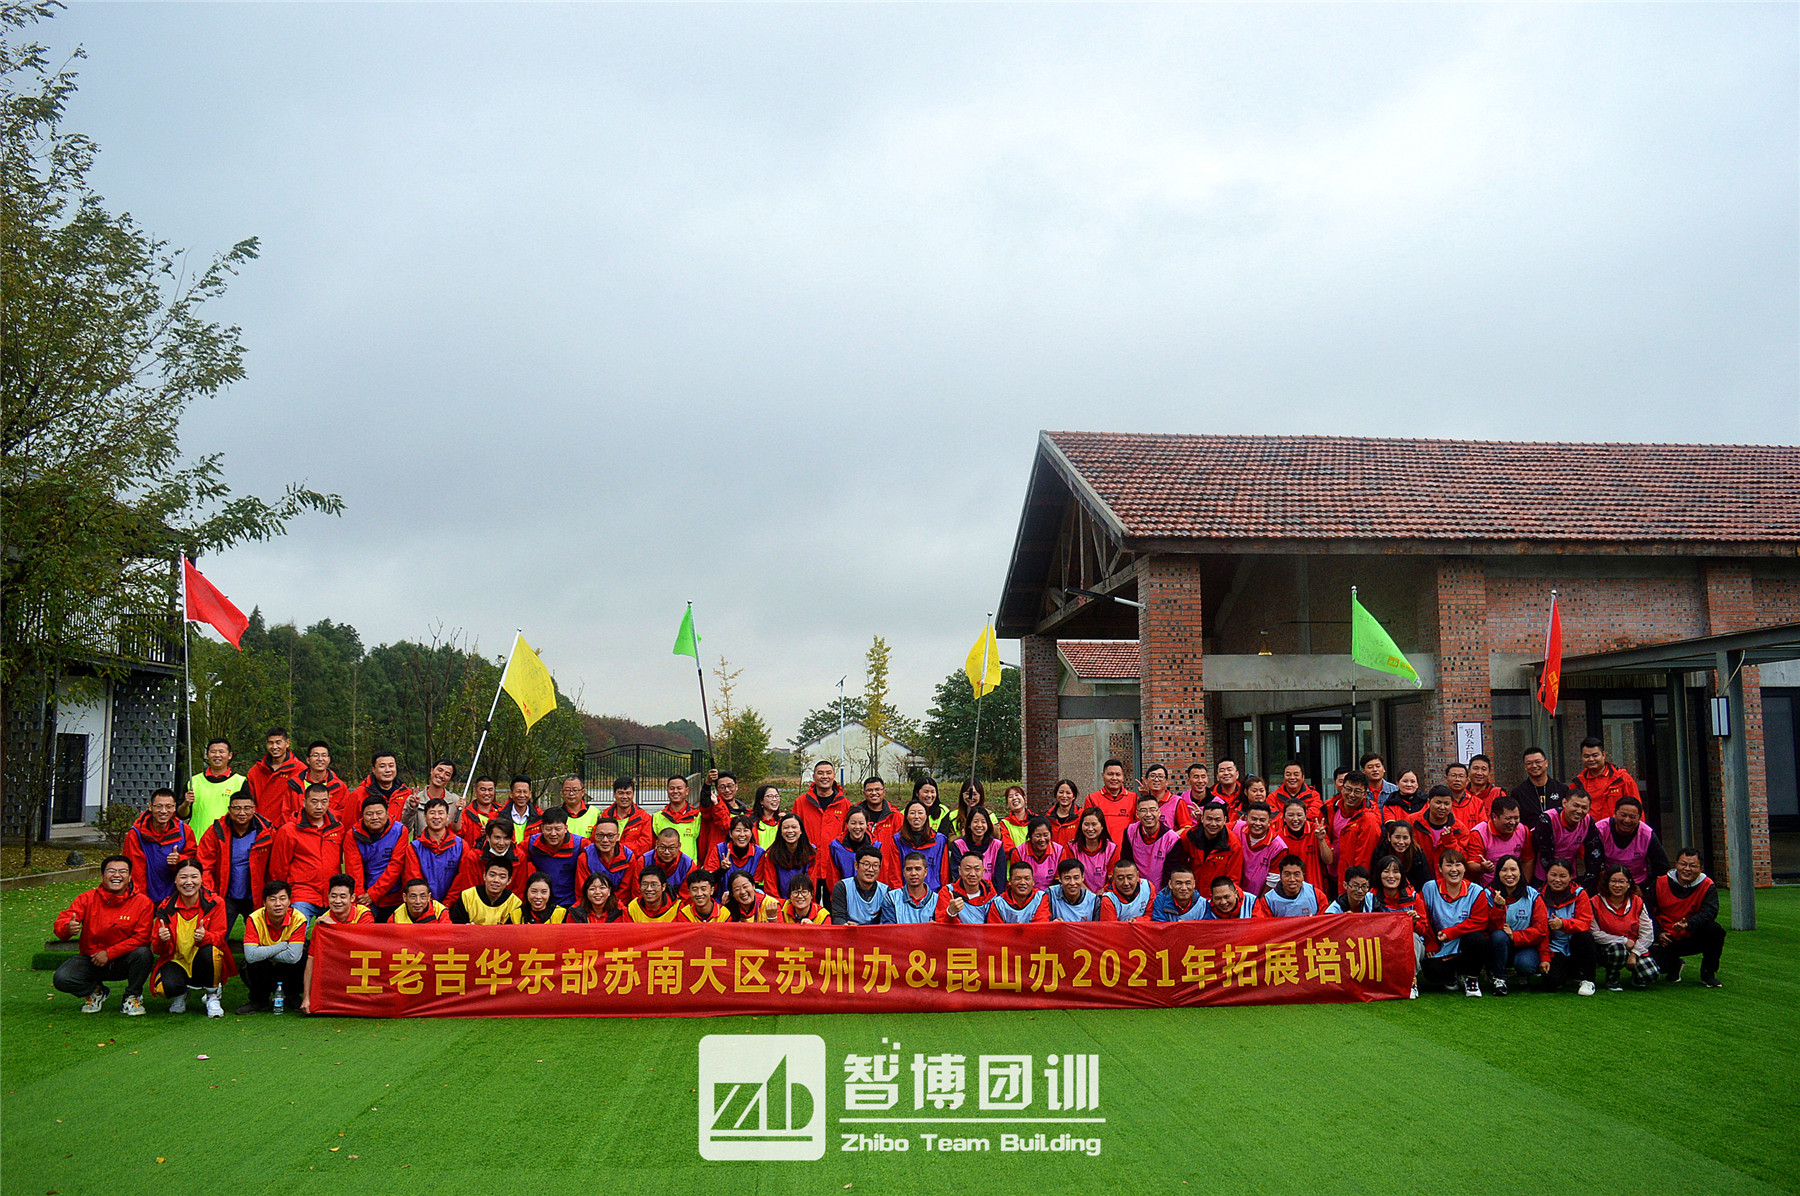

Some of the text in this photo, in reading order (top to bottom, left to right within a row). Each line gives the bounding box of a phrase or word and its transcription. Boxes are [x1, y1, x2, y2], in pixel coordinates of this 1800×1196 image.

[346, 937, 1384, 996] 王老吉华东部苏南大区苏州办&昆山办2021年拓展培训
